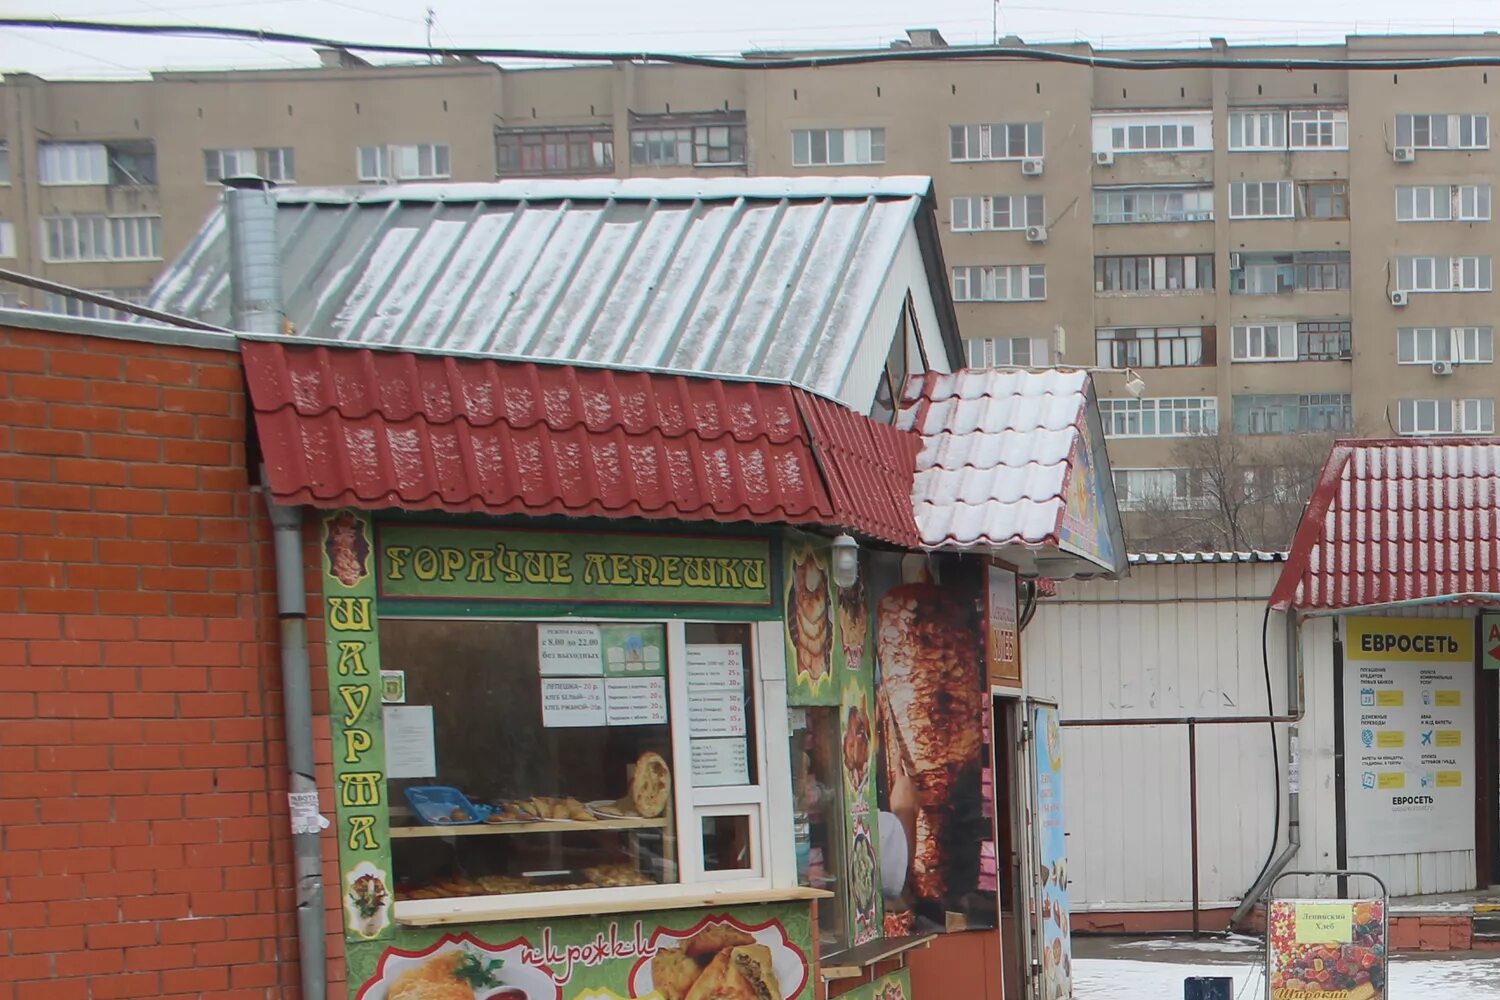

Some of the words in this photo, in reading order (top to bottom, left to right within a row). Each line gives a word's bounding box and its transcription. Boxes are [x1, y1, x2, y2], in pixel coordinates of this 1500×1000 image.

[385, 544, 573, 584] ГОРЯЧИЕ
[583, 552, 766, 589] ЛЕПЕШКИ
[1361, 633, 1459, 653] ЕВРОСЕТЬ
[1392, 796, 1434, 805] ЕВРОСЕТЬ
[1302, 913, 1346, 921] Ленинский
[1315, 922, 1335, 930] Хлеб
[520, 922, 660, 985] пирожки
[1275, 988, 1349, 1000] Широкий
